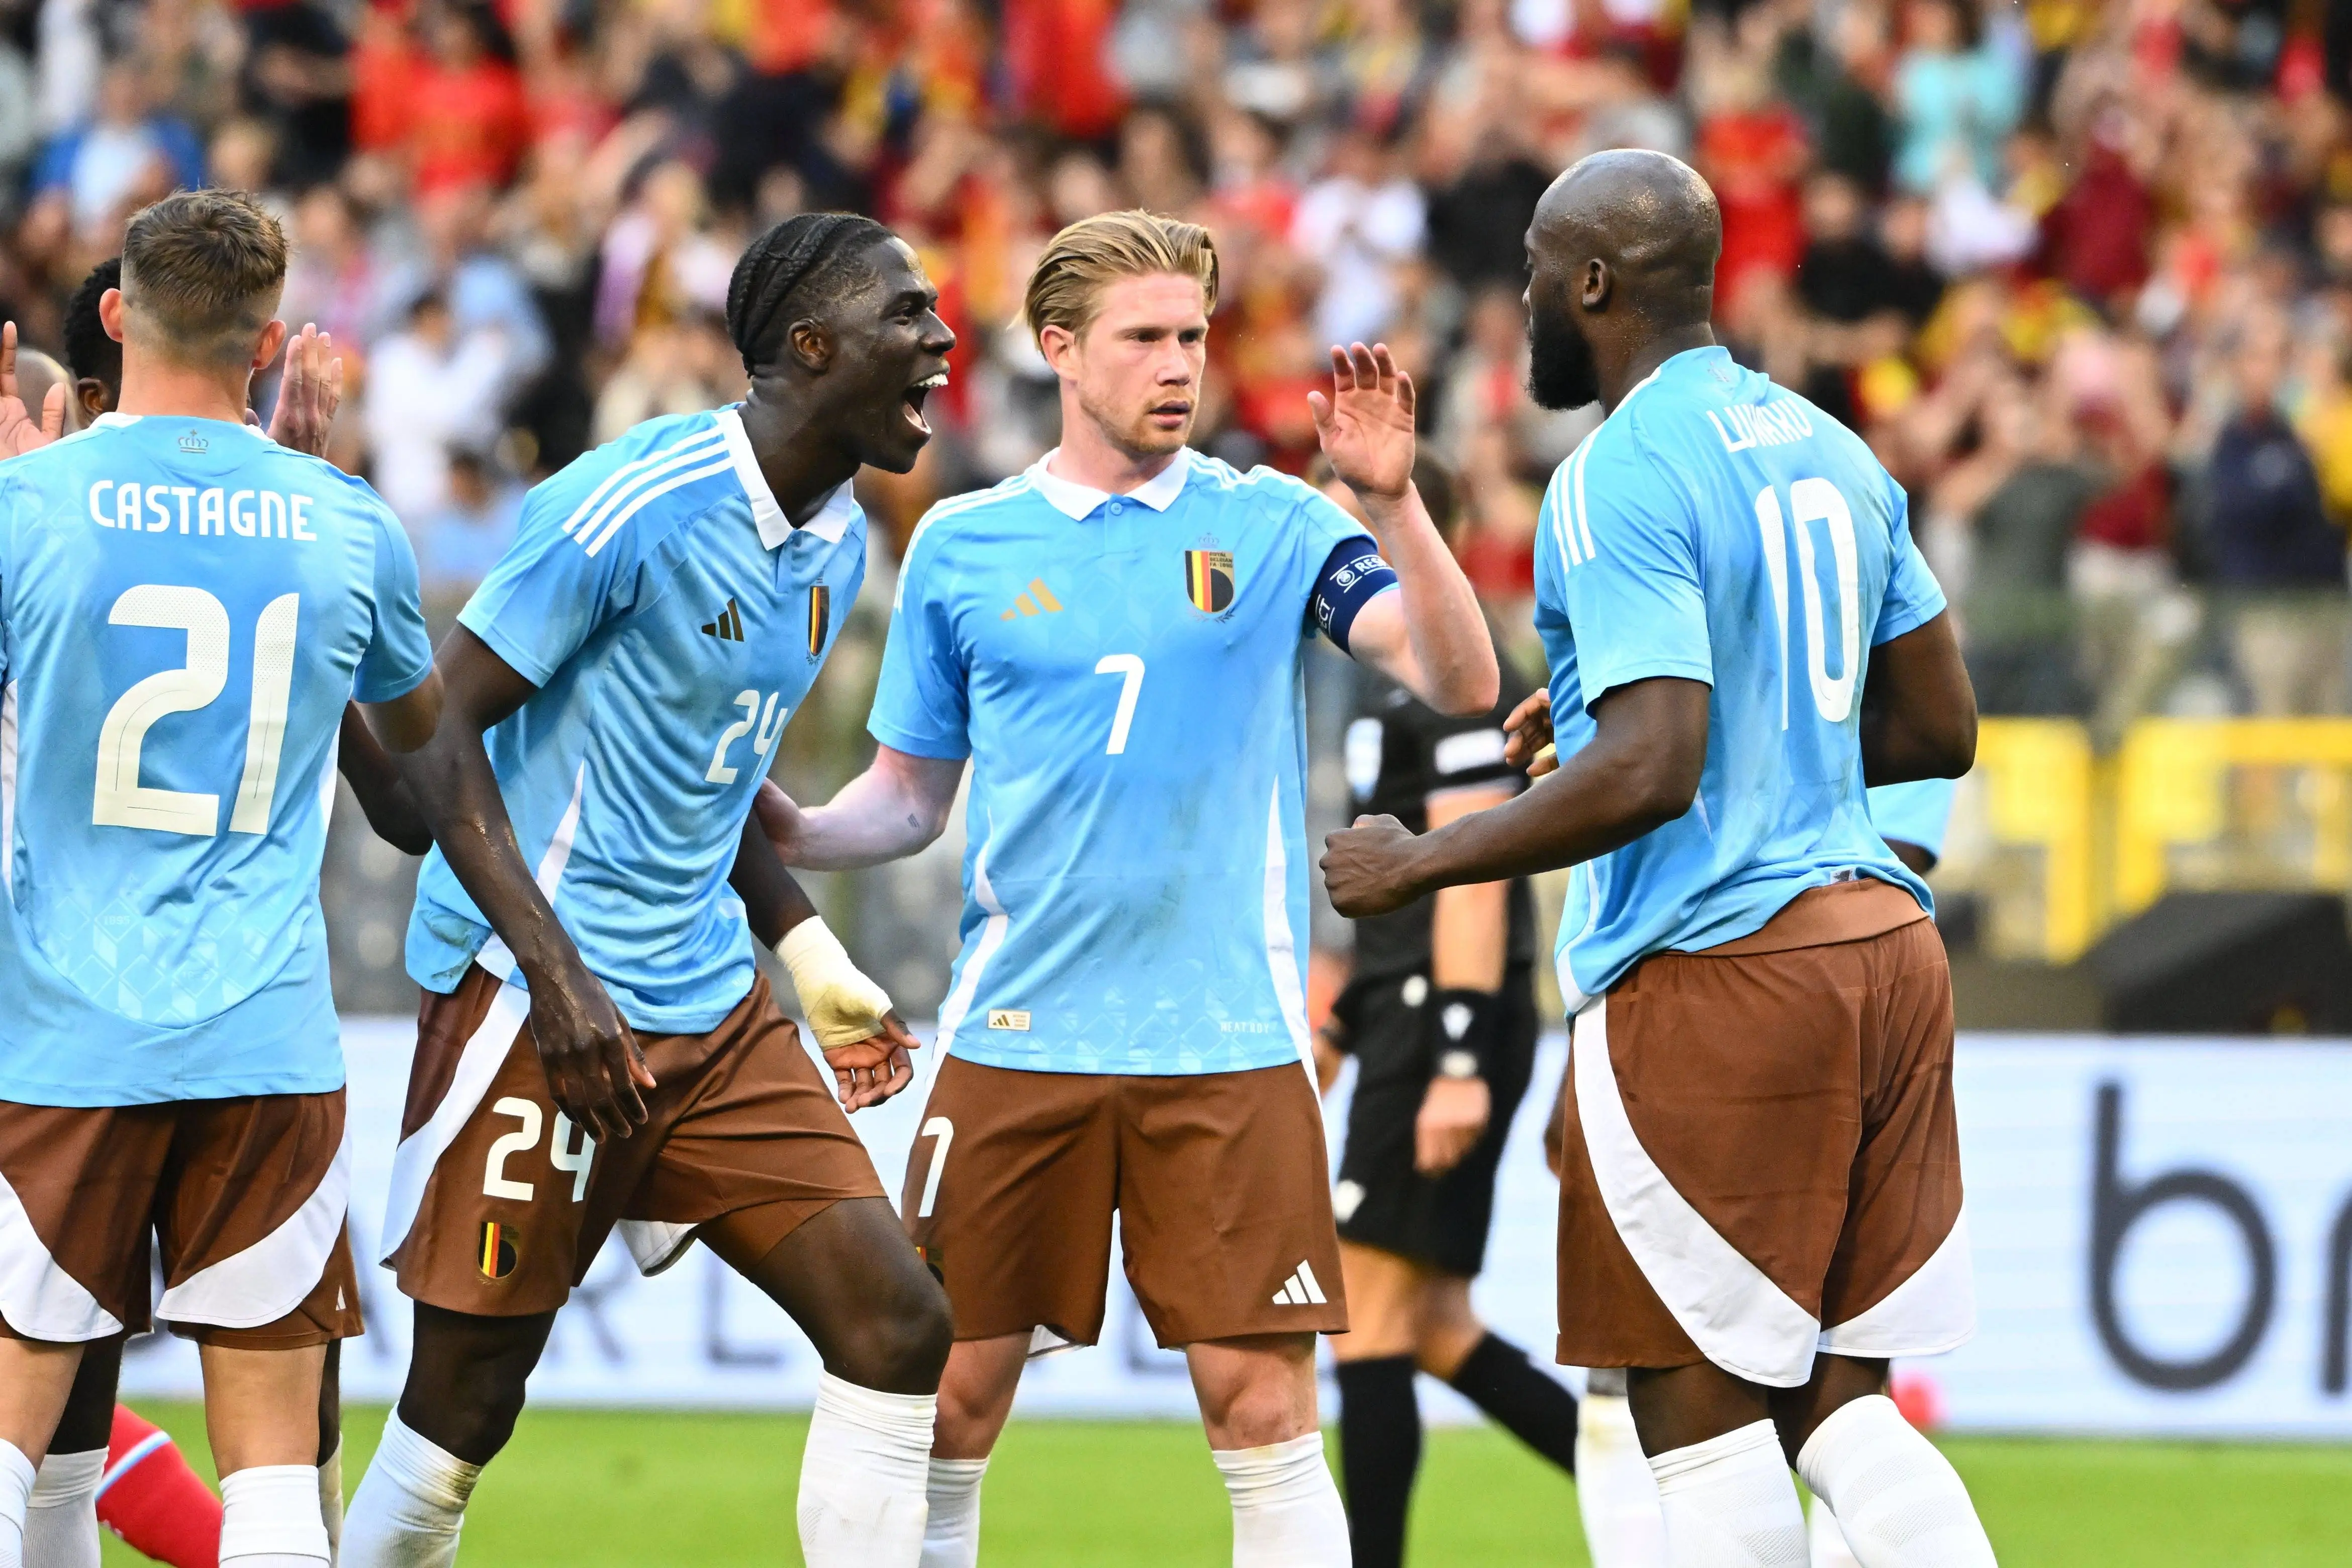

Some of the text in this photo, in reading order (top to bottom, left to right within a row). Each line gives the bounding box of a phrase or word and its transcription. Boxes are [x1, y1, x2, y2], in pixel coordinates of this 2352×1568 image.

[89, 480, 318, 542] CASTAGNE
[1754, 477, 1859, 731] 10
[92, 584, 300, 836] 21
[705, 690, 788, 785] 24
[1095, 654, 1145, 755] 7
[483, 1097, 597, 1202] 24
[918, 1117, 954, 1217] 7
